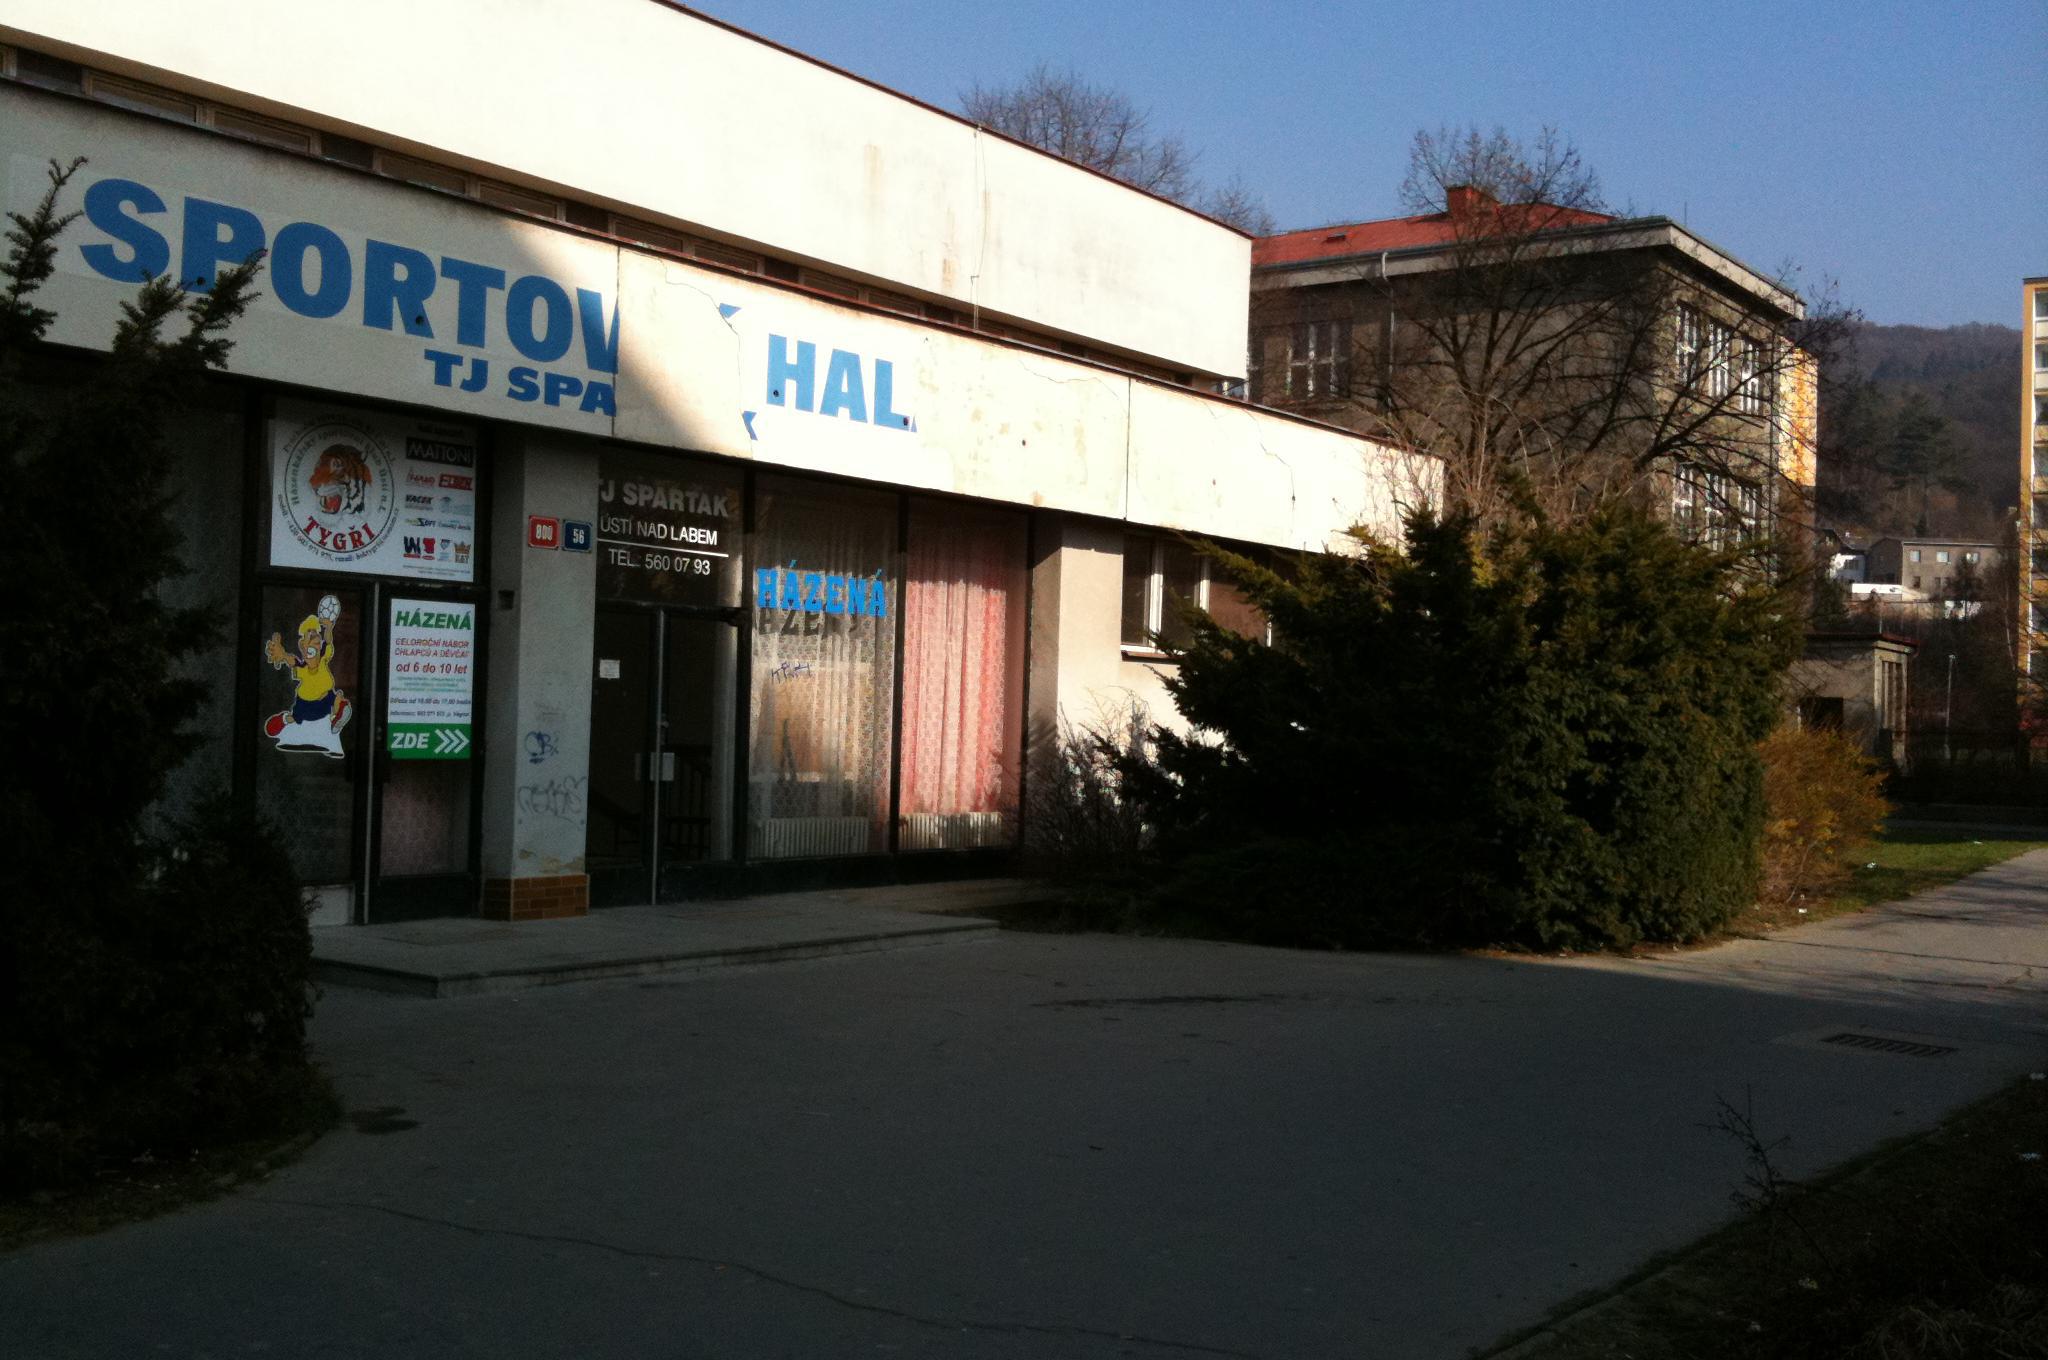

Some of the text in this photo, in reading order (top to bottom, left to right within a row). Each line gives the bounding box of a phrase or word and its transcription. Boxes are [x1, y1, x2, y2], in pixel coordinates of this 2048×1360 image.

[424, 350, 489, 392] TJ
[766, 333, 917, 432] HAL
[407, 441, 473, 464] MATTONI
[623, 482, 729, 518] SPARTAK
[303, 515, 376, 551] TYGŘI
[572, 528, 585, 544] 56
[637, 521, 668, 540] NAD
[670, 525, 718, 546] LABEM
[645, 553, 670, 571] 560
[674, 557, 691, 573] 07
[694, 559, 711, 576] 93
[757, 559, 886, 618] HÁZENÁ
[395, 608, 471, 630] HÁZENÁ
[396, 662, 468, 674] od 6 do 10 let
[391, 732, 430, 749] ZDE
